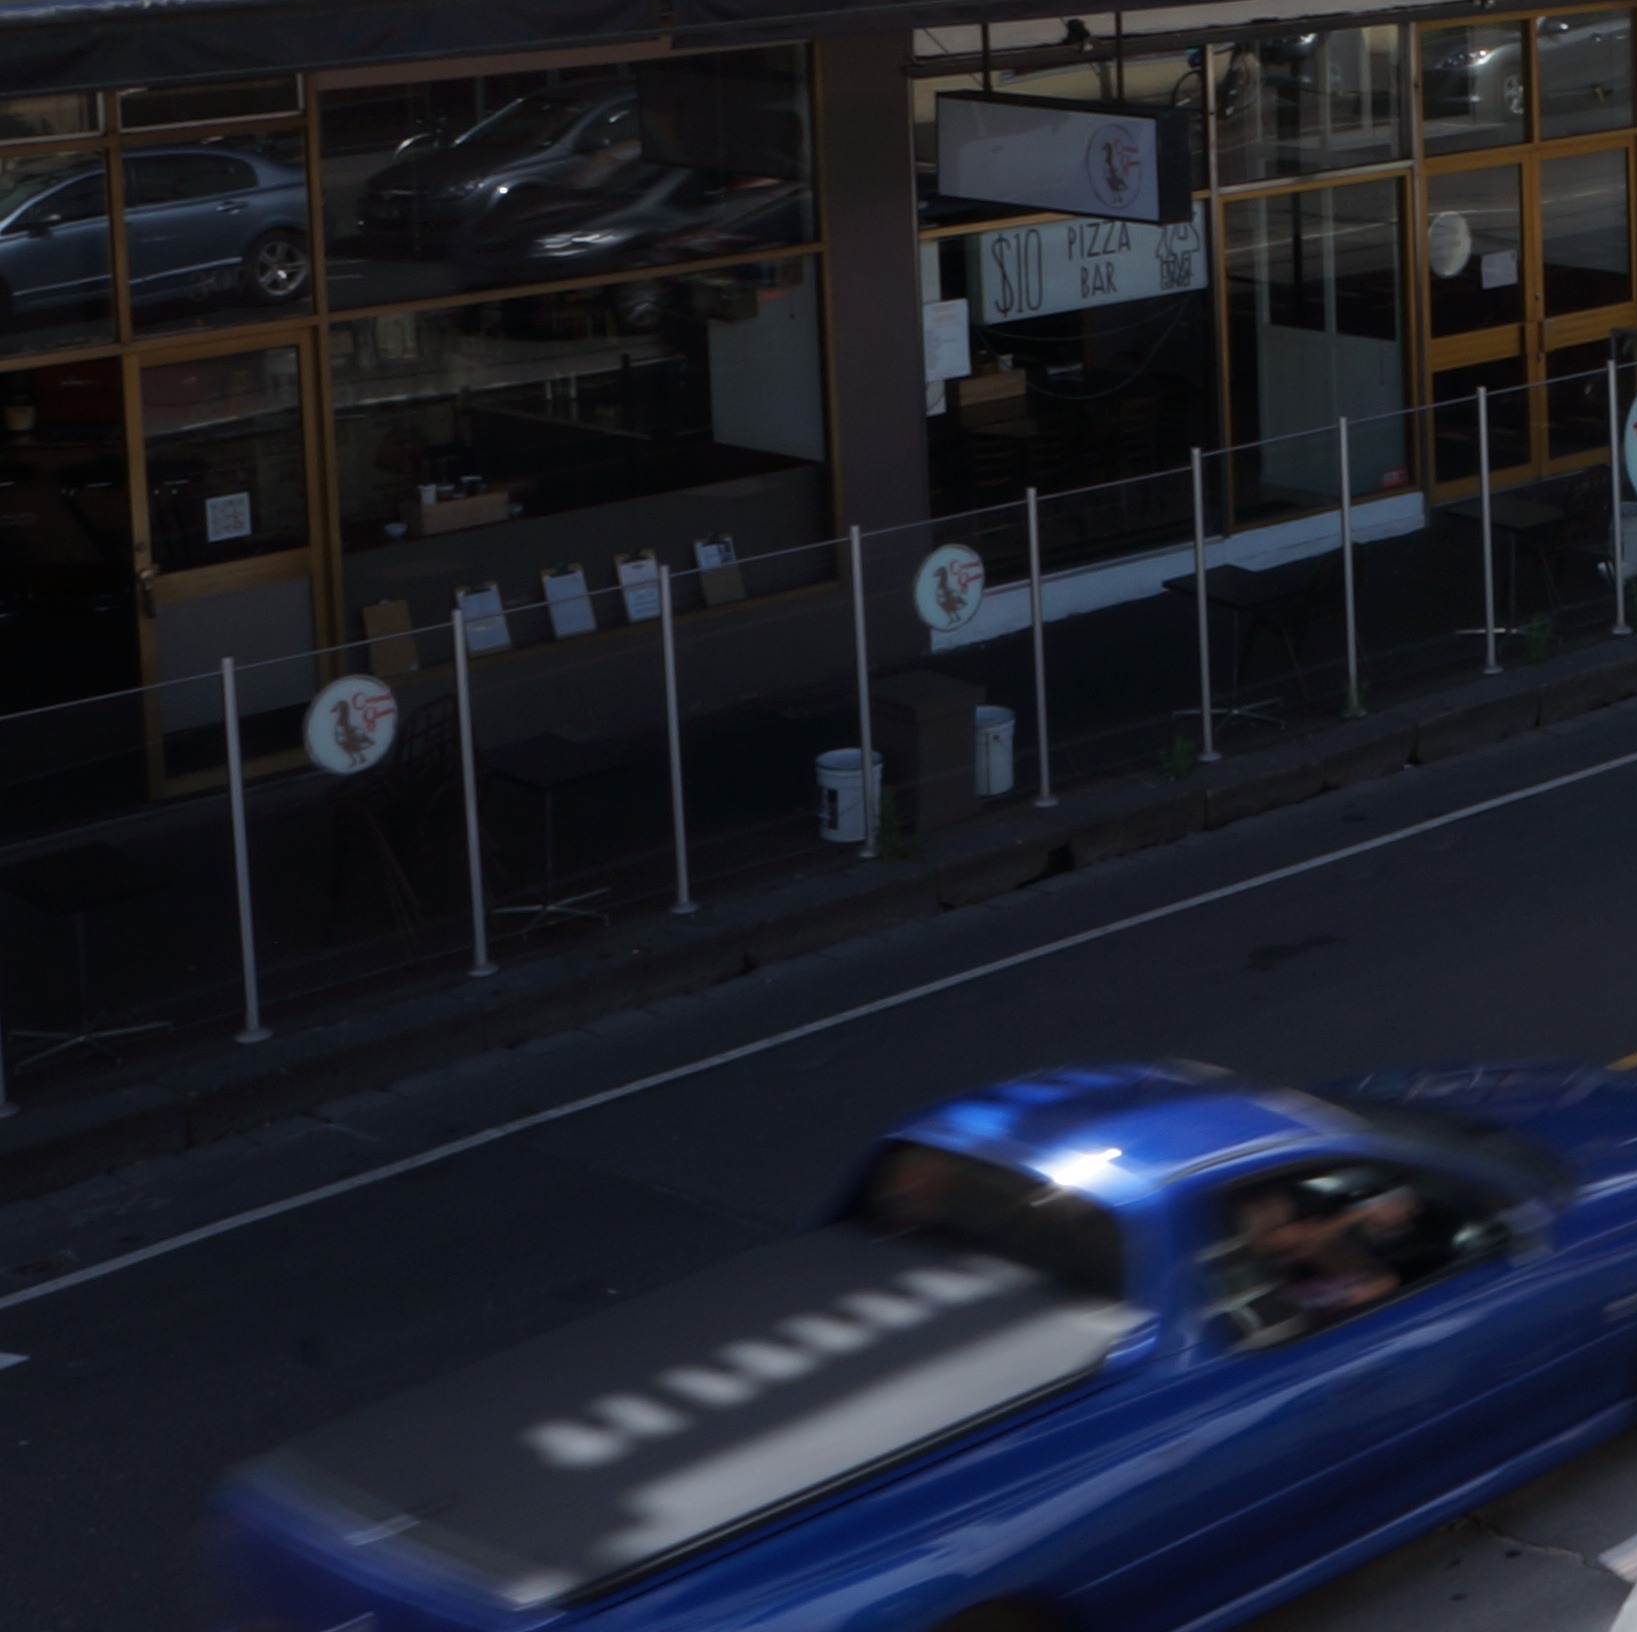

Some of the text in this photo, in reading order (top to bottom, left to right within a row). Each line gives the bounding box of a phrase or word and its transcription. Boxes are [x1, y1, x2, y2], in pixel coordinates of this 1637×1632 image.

[991, 229, 1042, 317] $10
[1068, 222, 1131, 260] PIZZA
[1080, 261, 1117, 299] BAR
